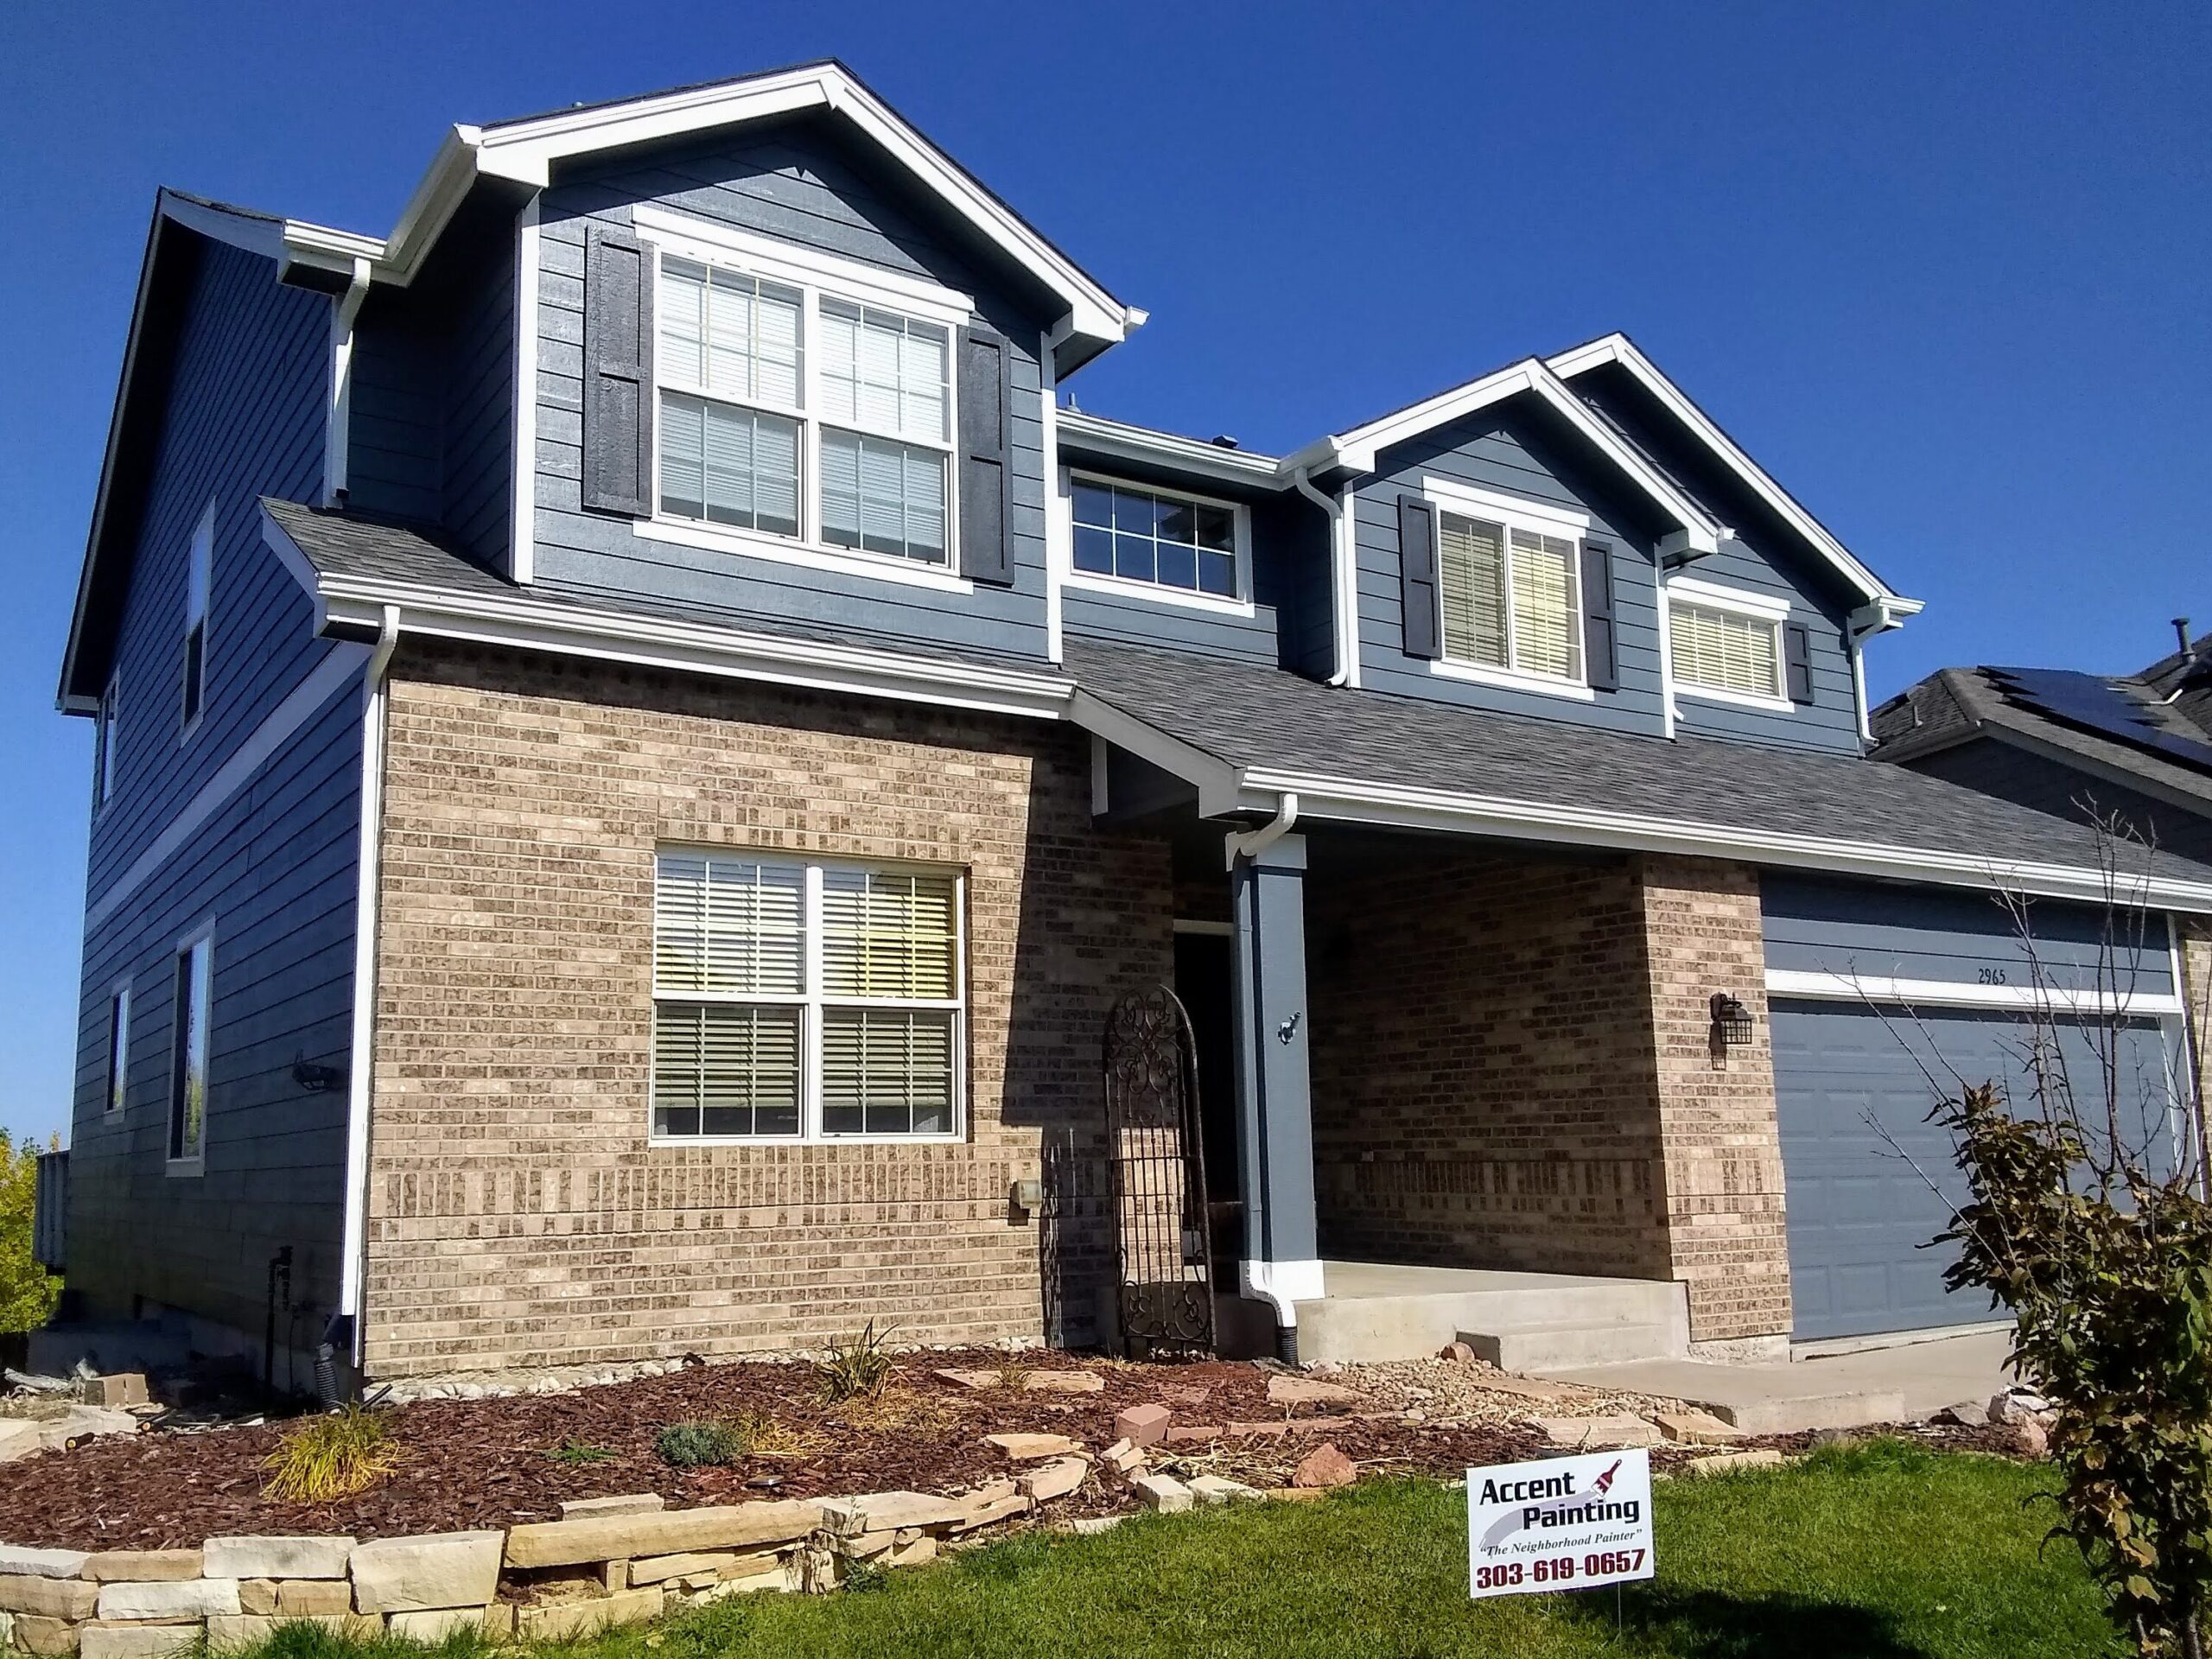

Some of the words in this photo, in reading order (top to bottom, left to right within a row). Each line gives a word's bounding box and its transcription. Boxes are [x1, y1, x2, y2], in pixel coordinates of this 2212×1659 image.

[1979, 968, 2005, 985] 2965
[1479, 1472, 1575, 1505] Accent
[1523, 1499, 1639, 1530] Painting
[1511, 1535, 1591, 1554] Neighborhood
[1477, 1548, 1645, 1590] 303-619-0657
